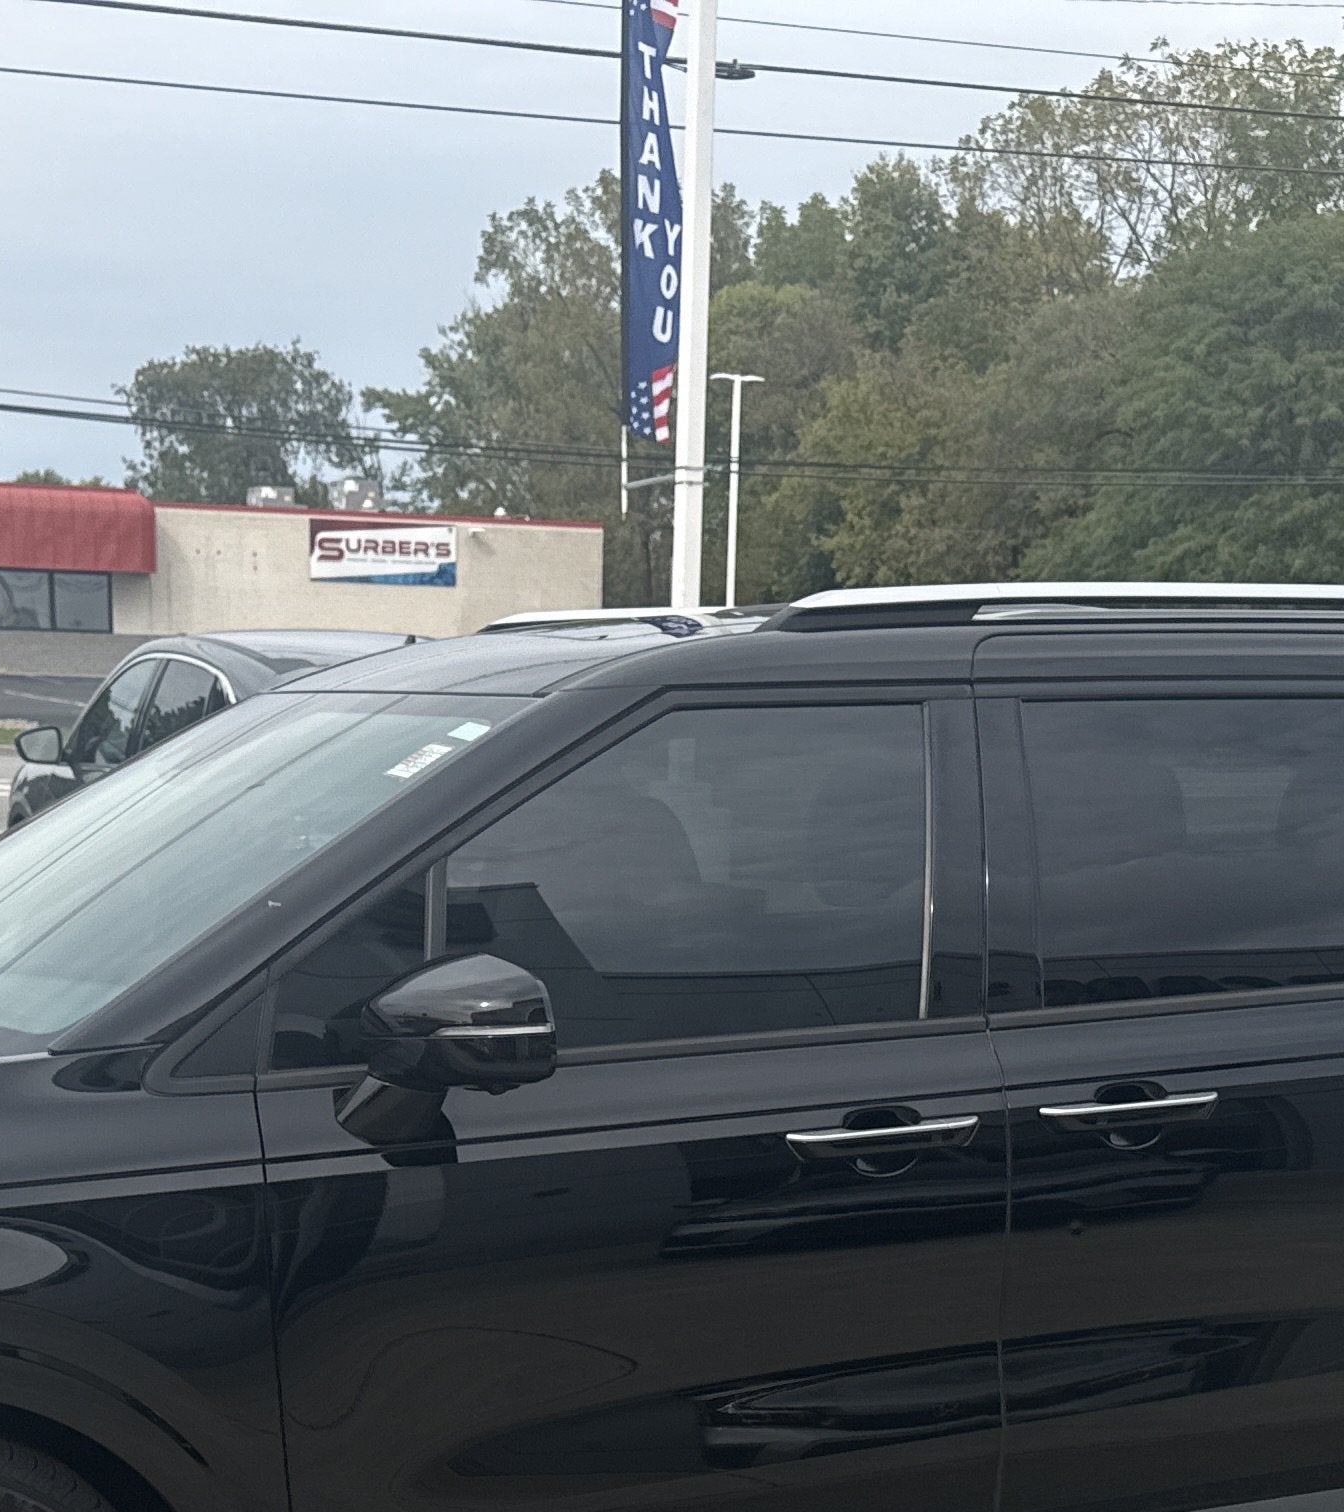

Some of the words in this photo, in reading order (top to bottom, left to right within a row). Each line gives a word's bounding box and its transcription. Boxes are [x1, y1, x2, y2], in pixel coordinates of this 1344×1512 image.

[632, 40, 662, 260] THANK
[652, 218, 682, 343] YOU
[317, 537, 452, 562] SURBER'S
